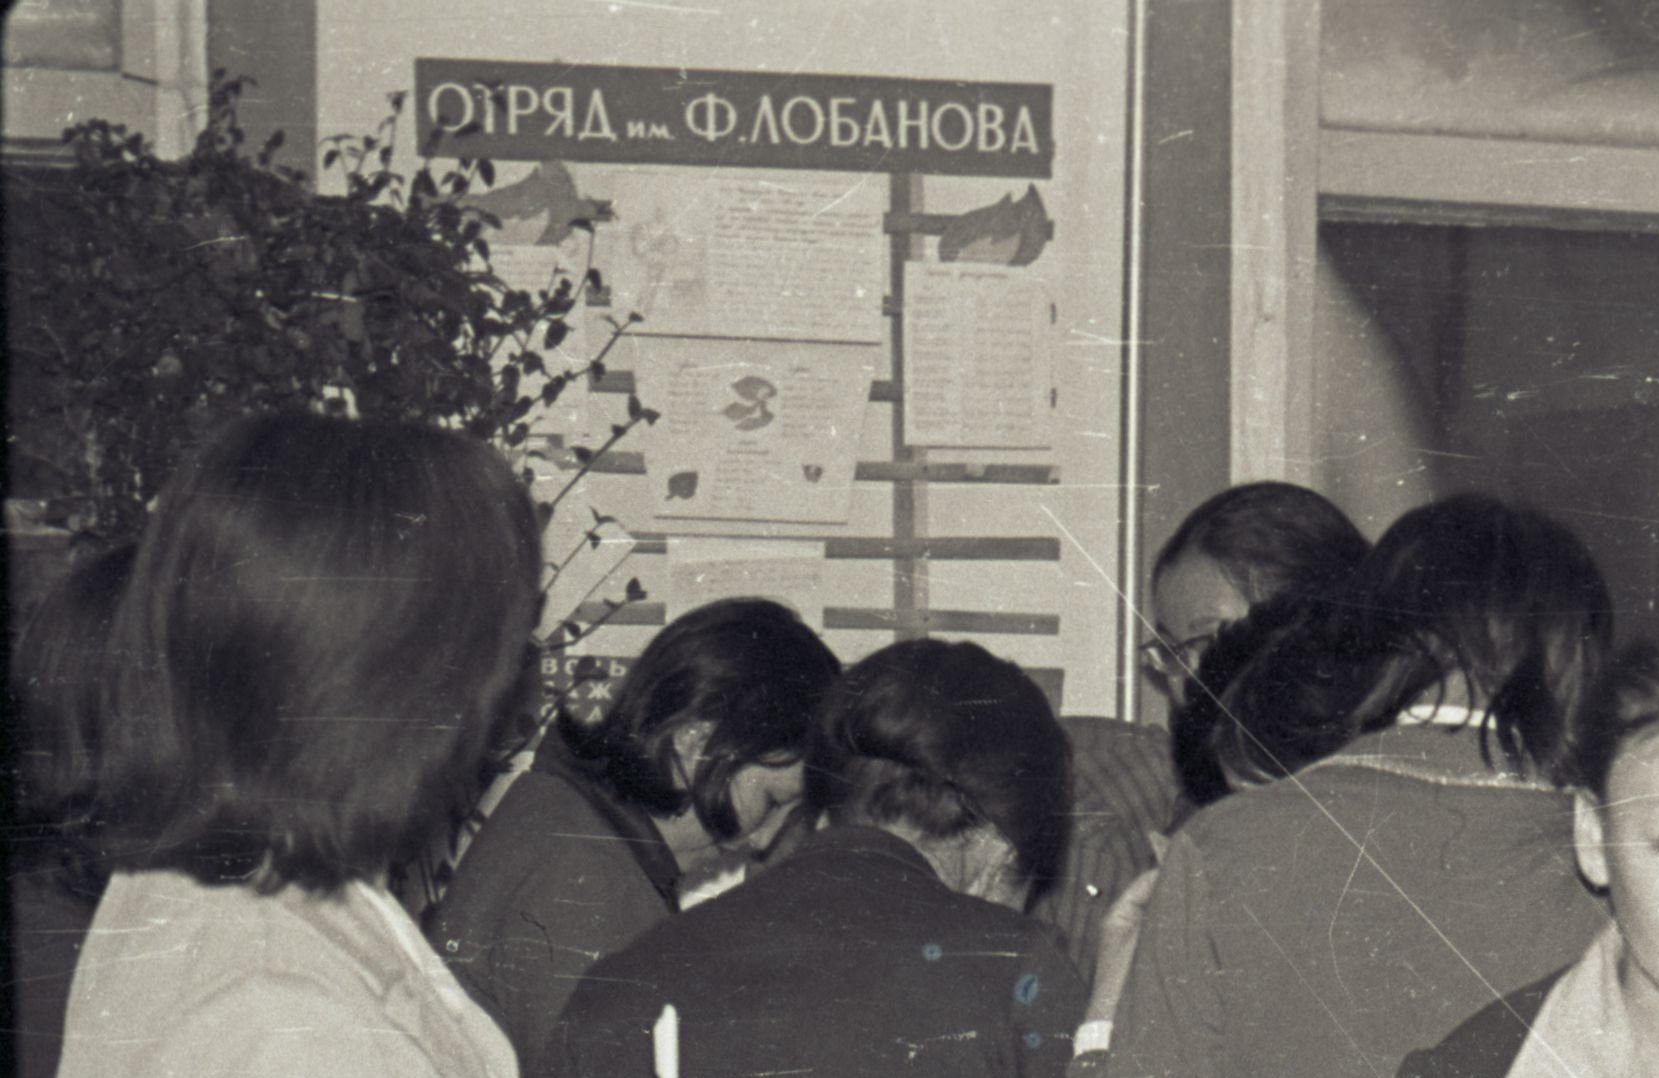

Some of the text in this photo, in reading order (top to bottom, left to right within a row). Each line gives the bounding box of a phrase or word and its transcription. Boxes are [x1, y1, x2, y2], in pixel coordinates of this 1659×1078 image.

[428, 82, 1039, 154] ОТРЯД им. Ф.ЛОБАНОВА
